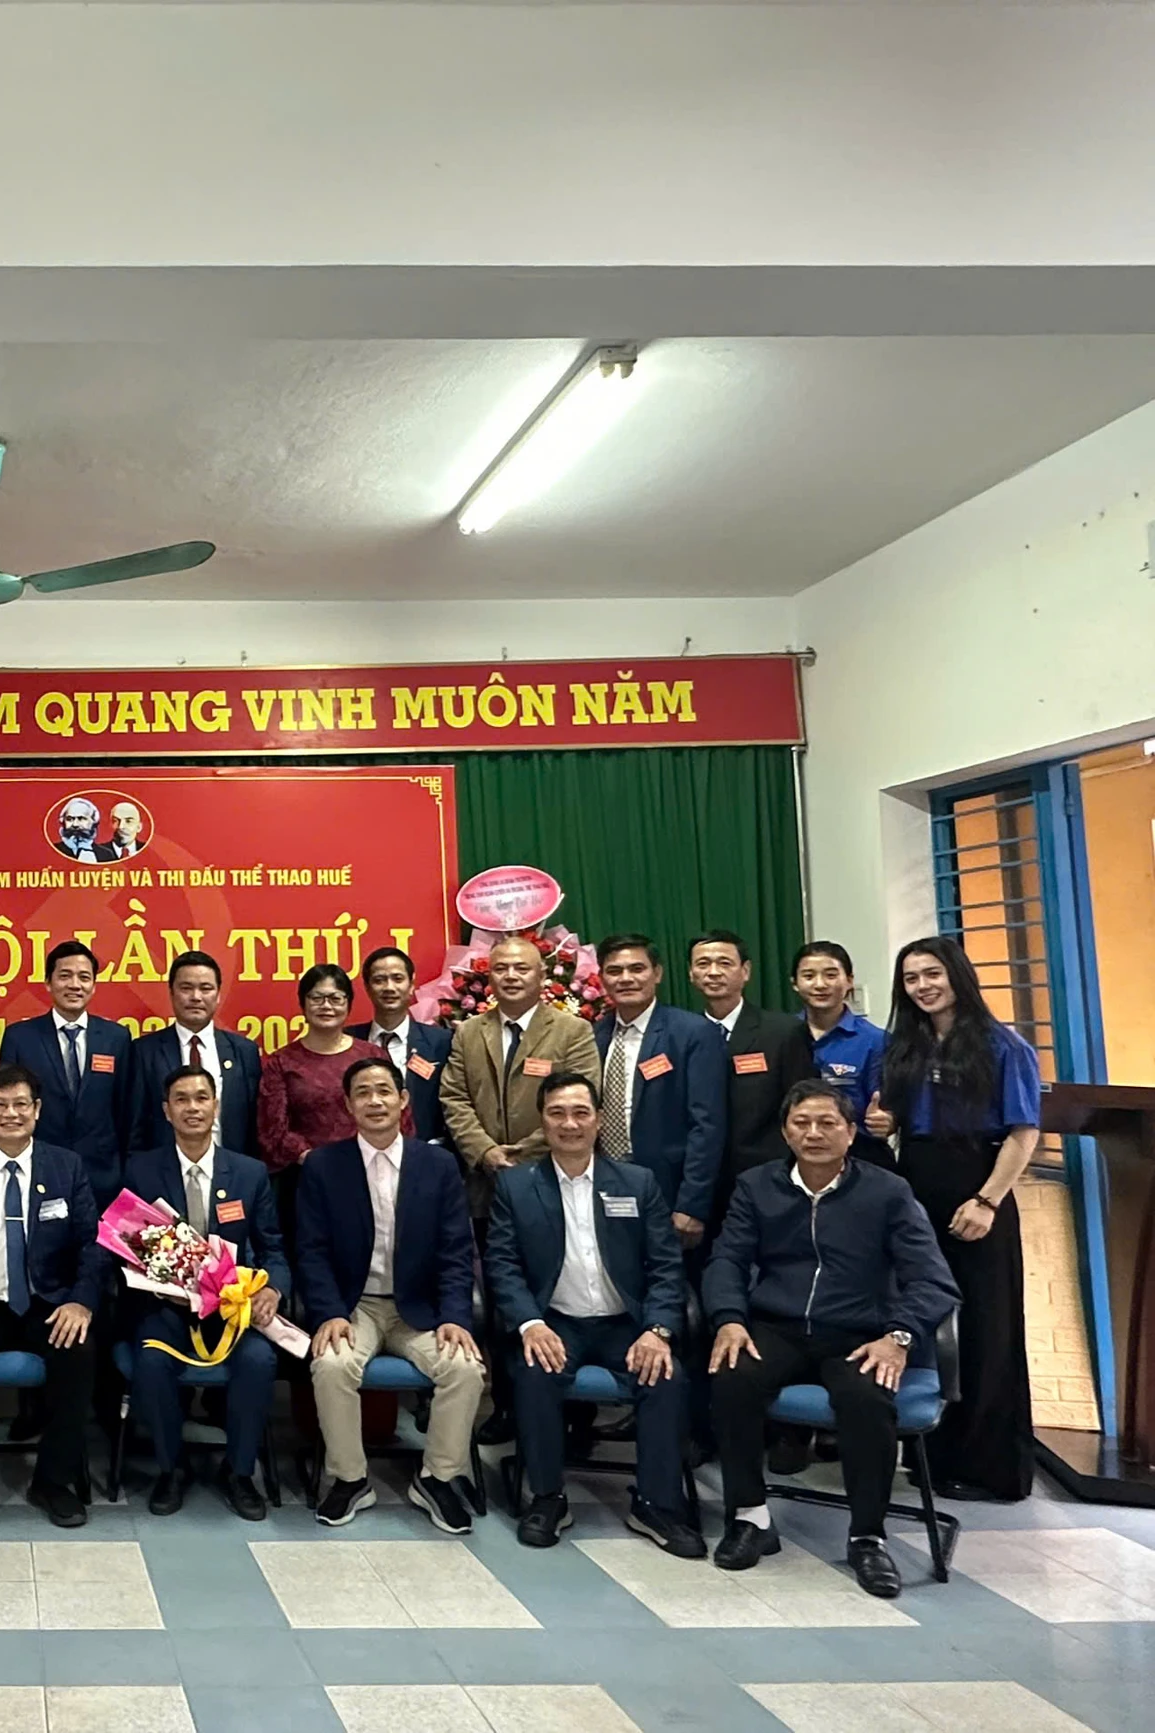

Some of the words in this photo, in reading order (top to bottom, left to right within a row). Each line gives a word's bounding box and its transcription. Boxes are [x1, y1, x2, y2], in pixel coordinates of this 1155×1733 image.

[34, 690, 232, 737] QUANG
[242, 688, 377, 732] VINH
[391, 672, 556, 729] MUÔN
[569, 670, 697, 724] NĂM
[16, 865, 65, 888] HUẤN
[70, 868, 124, 890] LUYỆN
[129, 867, 153, 887] VÀ
[157, 869, 184, 887] THI
[189, 864, 226, 886] ĐẤU
[230, 863, 263, 886] THỂ
[267, 868, 312, 886] THAO
[316, 864, 352, 886] HUẾ
[227, 911, 369, 981] THỨ
